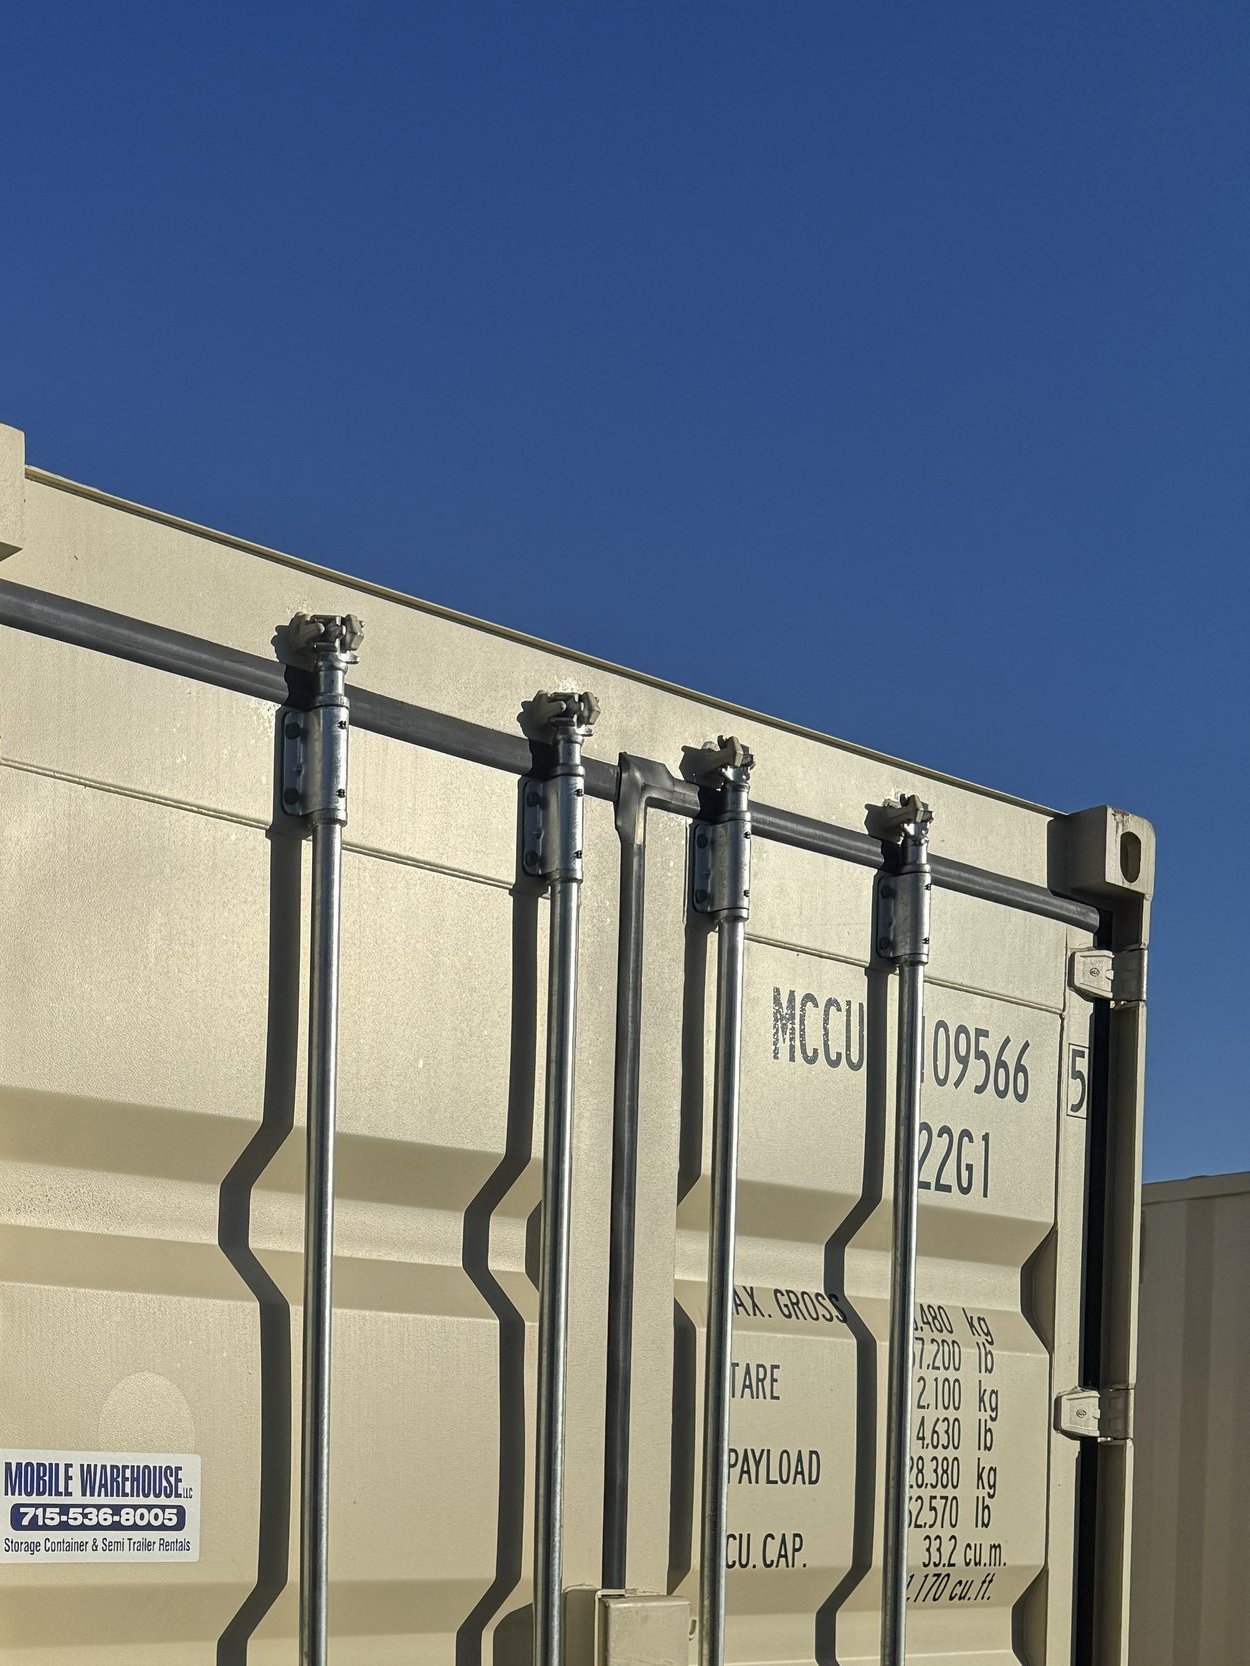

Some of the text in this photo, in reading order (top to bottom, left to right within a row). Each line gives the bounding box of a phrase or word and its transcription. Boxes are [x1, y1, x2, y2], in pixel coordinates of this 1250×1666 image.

[772, 986, 865, 1072] MCCU
[1069, 1049, 1087, 1114] 5
[917, 1120, 991, 1199] 22G1
[732, 1285, 848, 1324] AX. GROSS
[961, 1307, 995, 1346] kg
[975, 1341, 995, 1375] lb
[730, 1361, 781, 1401] TARE
[978, 1379, 999, 1423] kg
[977, 1418, 994, 1452] lb
[4, 1461, 193, 1500] MOBILE WAREHOUSE LLC
[727, 1447, 822, 1486] PAYLOAD
[976, 1457, 997, 1500] kg
[19, 1506, 178, 1527] 715-536-8005
[975, 1495, 991, 1529] lb
[4, 1537, 191, 1556] Storage Container & Semi Trailer Rentals
[922, 1534, 958, 1568] 33.2
